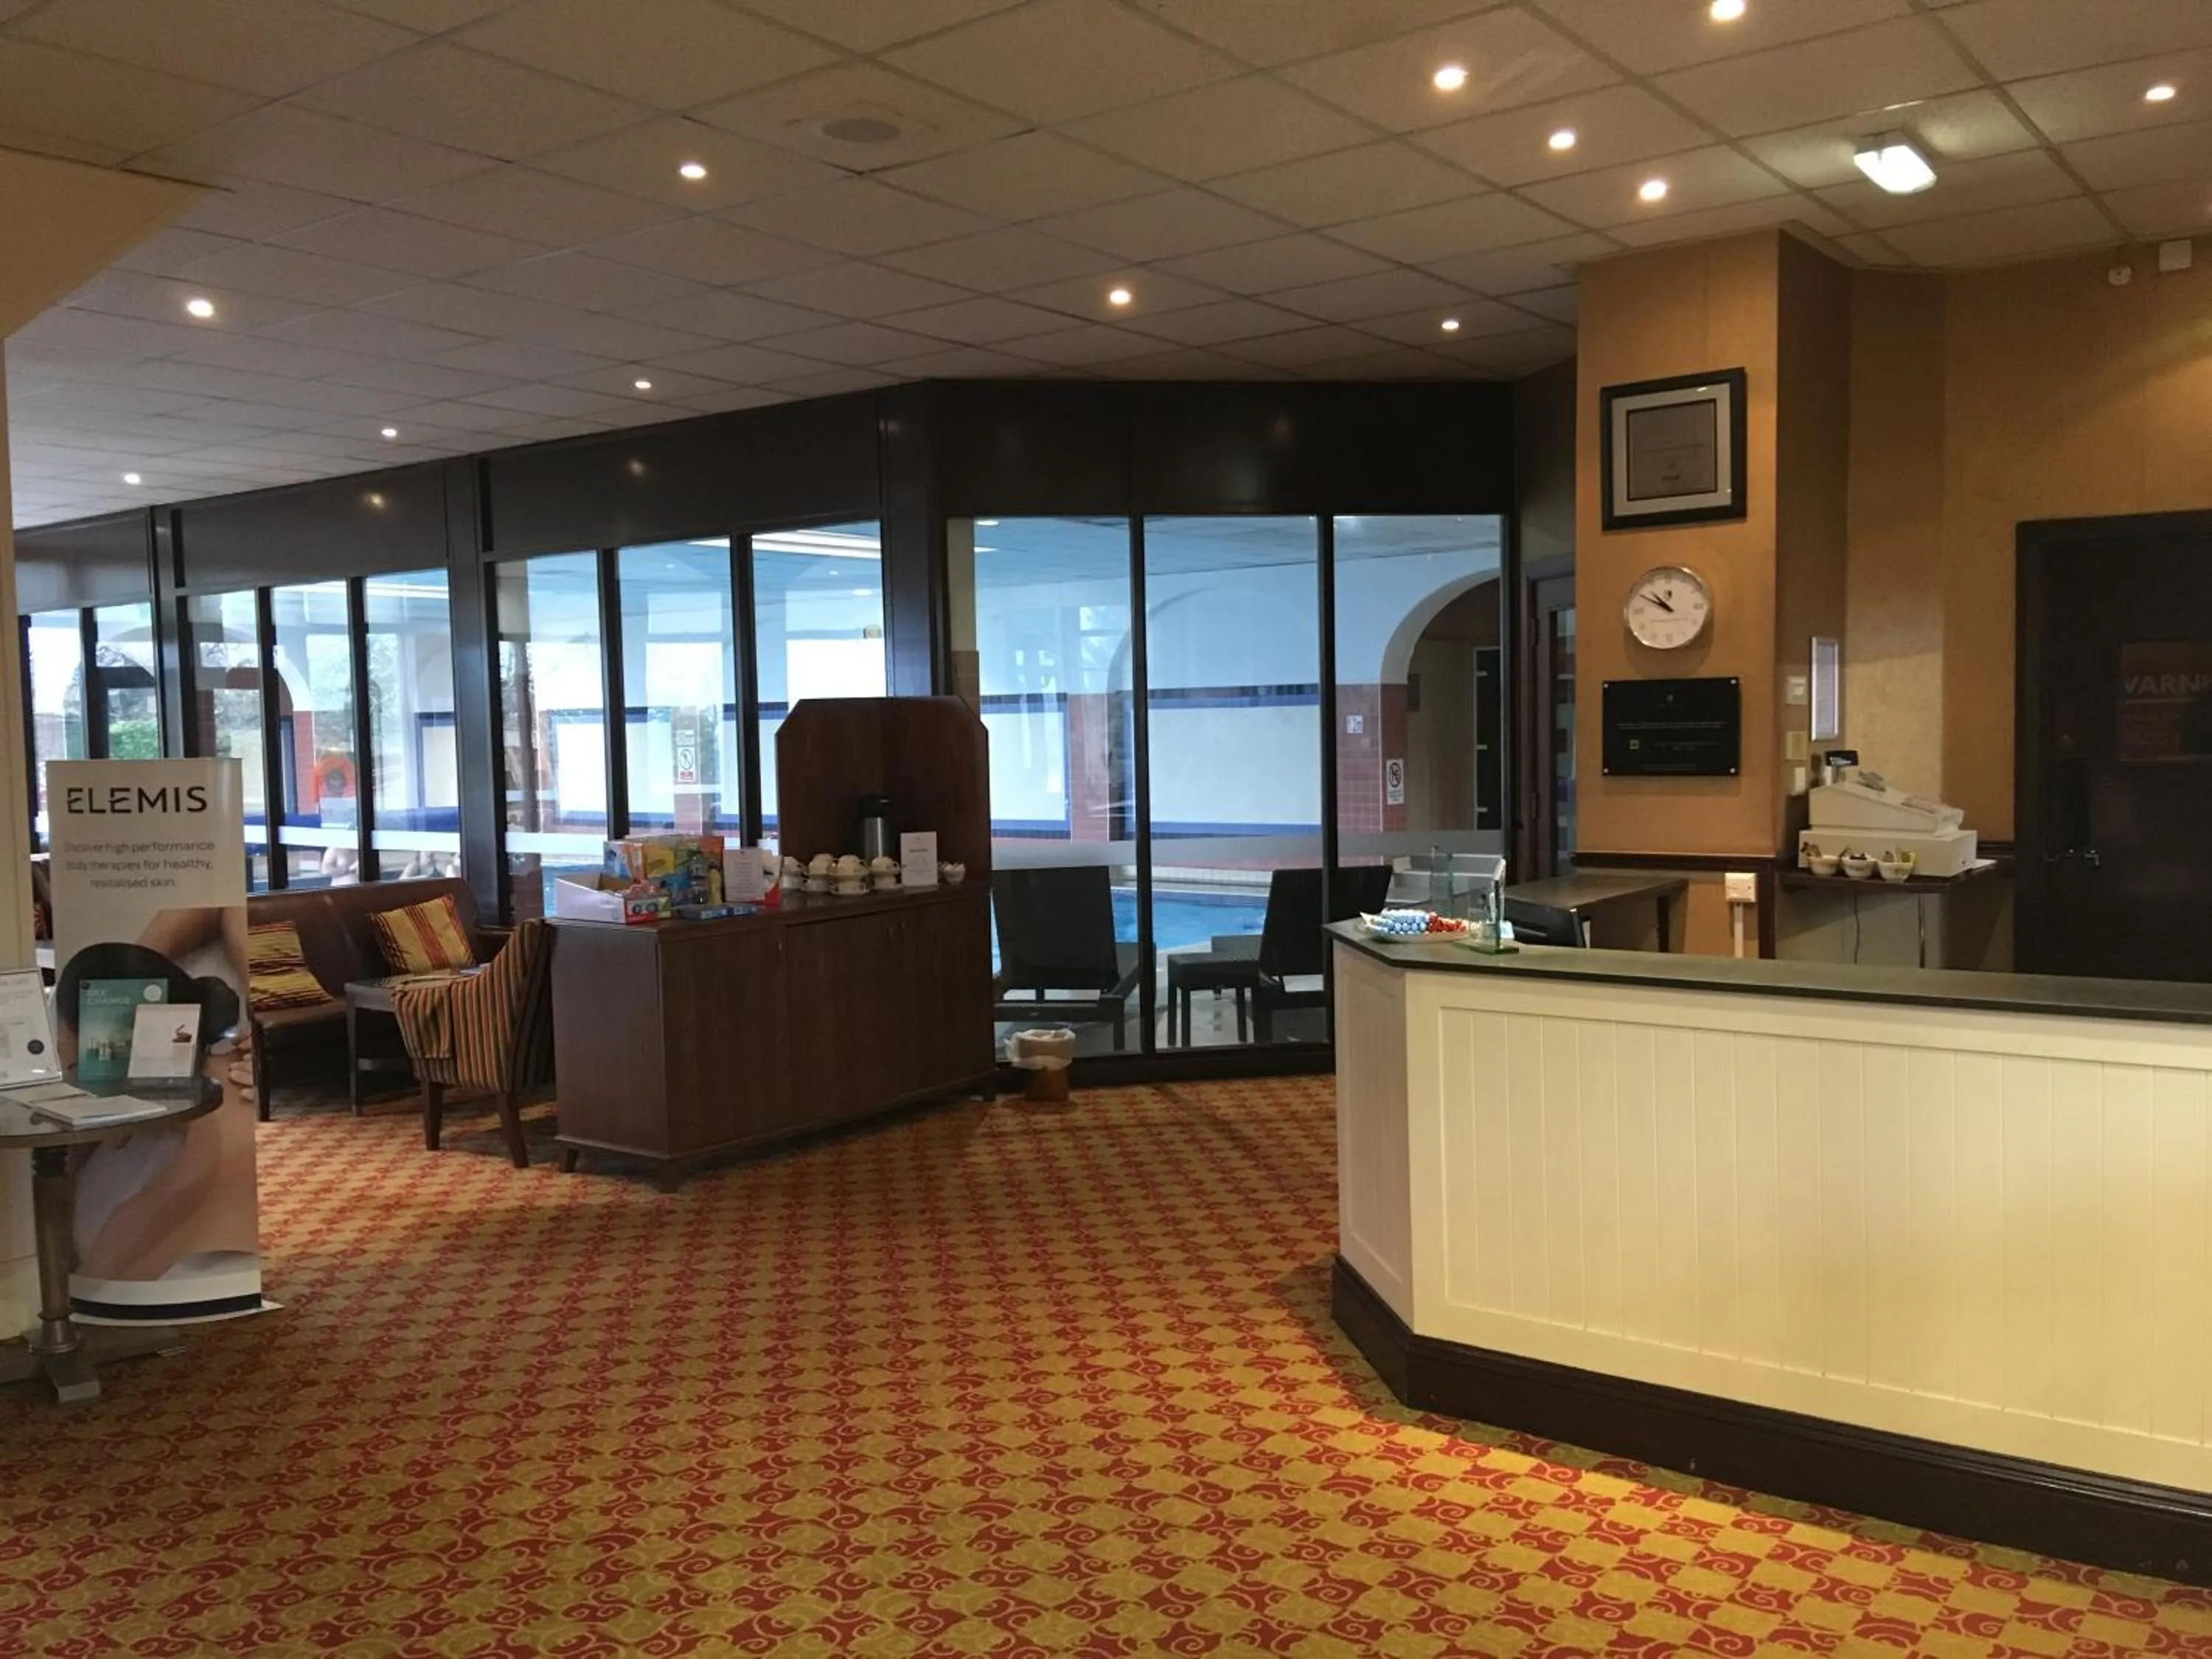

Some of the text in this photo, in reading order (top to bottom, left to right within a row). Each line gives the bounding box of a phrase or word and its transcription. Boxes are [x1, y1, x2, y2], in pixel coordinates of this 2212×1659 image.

[66, 786, 207, 814] ELEMIS
[133, 841, 215, 854] performance
[144, 858, 160, 870] for
